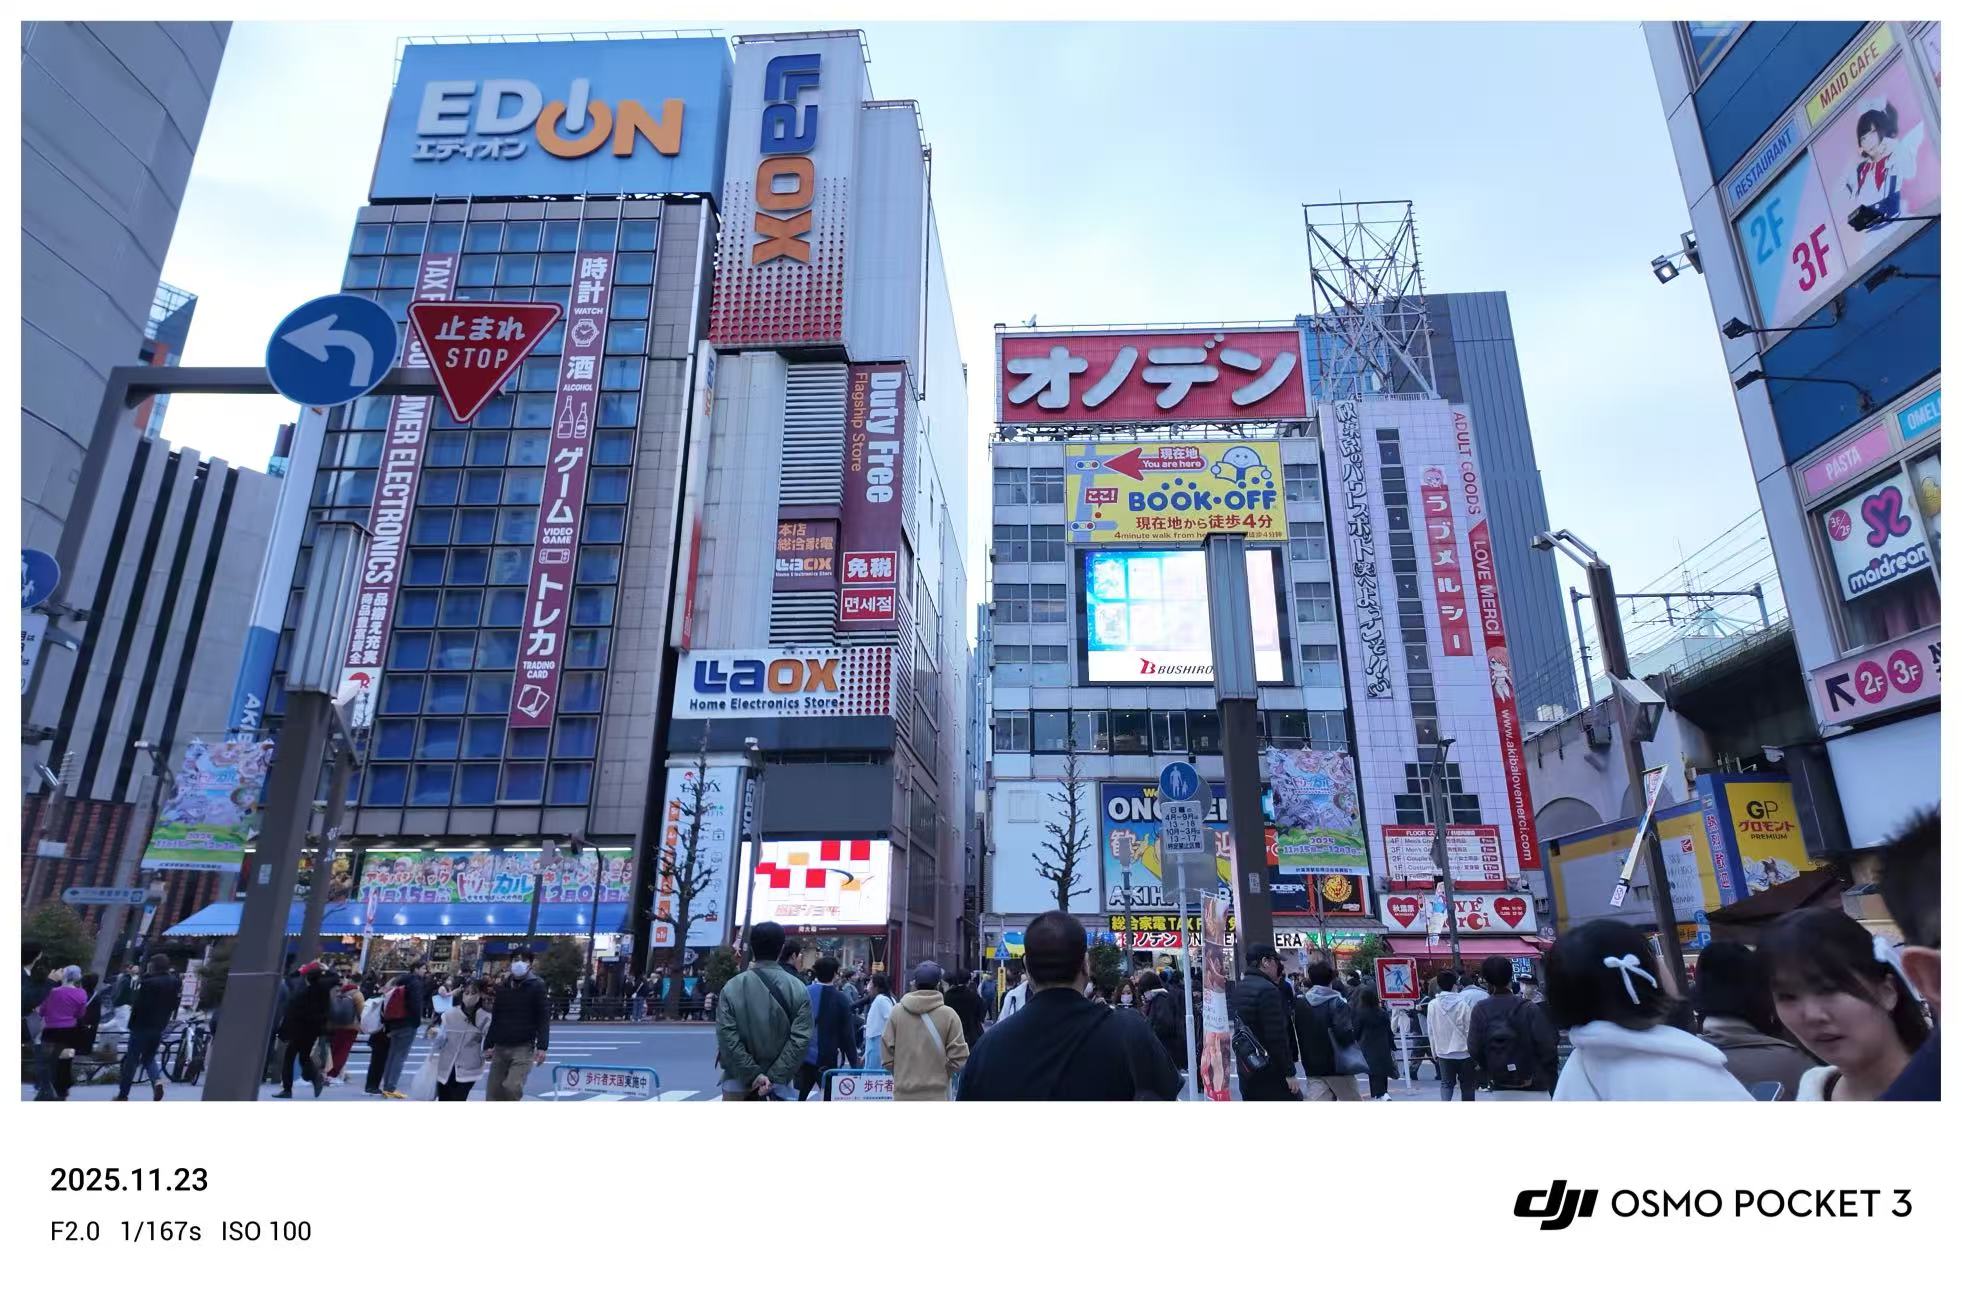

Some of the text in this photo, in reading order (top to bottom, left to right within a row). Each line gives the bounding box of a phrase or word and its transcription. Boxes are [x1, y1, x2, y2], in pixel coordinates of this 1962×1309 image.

[1818, 41, 1880, 109] MAID CAFE
[415, 76, 686, 159] EDION
[411, 138, 528, 161] エディオン
[1735, 128, 1793, 200] RESTAURANT
[1751, 197, 1785, 266] 2F
[1792, 224, 1830, 292] 3F
[421, 256, 453, 291] TAX
[578, 256, 609, 305] 時計
[574, 307, 604, 316] WATCH
[434, 315, 526, 342] 止まれ
[444, 347, 509, 370] STOP
[566, 355, 597, 381] 酒
[1006, 332, 1297, 410] オノデン
[562, 383, 593, 392] ALCOHOL
[851, 371, 869, 473] Flagship Store
[1907, 397, 1941, 430] OMEL
[865, 371, 903, 503] Duty Free
[1142, 460, 1160, 469] You
[1179, 460, 1201, 468] here
[1158, 446, 1200, 460] 現在地
[1453, 411, 1481, 516] ADULT GOODS
[1825, 445, 1863, 481] PASTA
[545, 446, 584, 524] ゲーム
[1087, 490, 1116, 502] ここ!
[365, 448, 417, 585] ELECTRONICS
[778, 522, 808, 536] 本店
[1135, 513, 1273, 530] 現在地から徒歩4分
[542, 536, 572, 545] GAME
[543, 527, 573, 536] VIDEO
[777, 536, 834, 551] 総合家電
[847, 556, 893, 580] 免税
[1426, 495, 1464, 649] ラブメルシー
[1473, 540, 1500, 636] LOVE MERCI
[526, 572, 564, 657] トレカ
[844, 596, 893, 615] 면세점
[523, 660, 556, 671] TRADING
[526, 670, 549, 680] CARD
[1893, 660, 1921, 685] 3F
[1860, 670, 1885, 696] 2F
[689, 696, 840, 711] Home Electronics Store
[1501, 708, 1533, 861] www.akibalovemerci.com
[1746, 800, 1778, 819] GP
[1738, 821, 1796, 833] グロモント
[585, 1071, 647, 1089] 歩行者天国実施中
